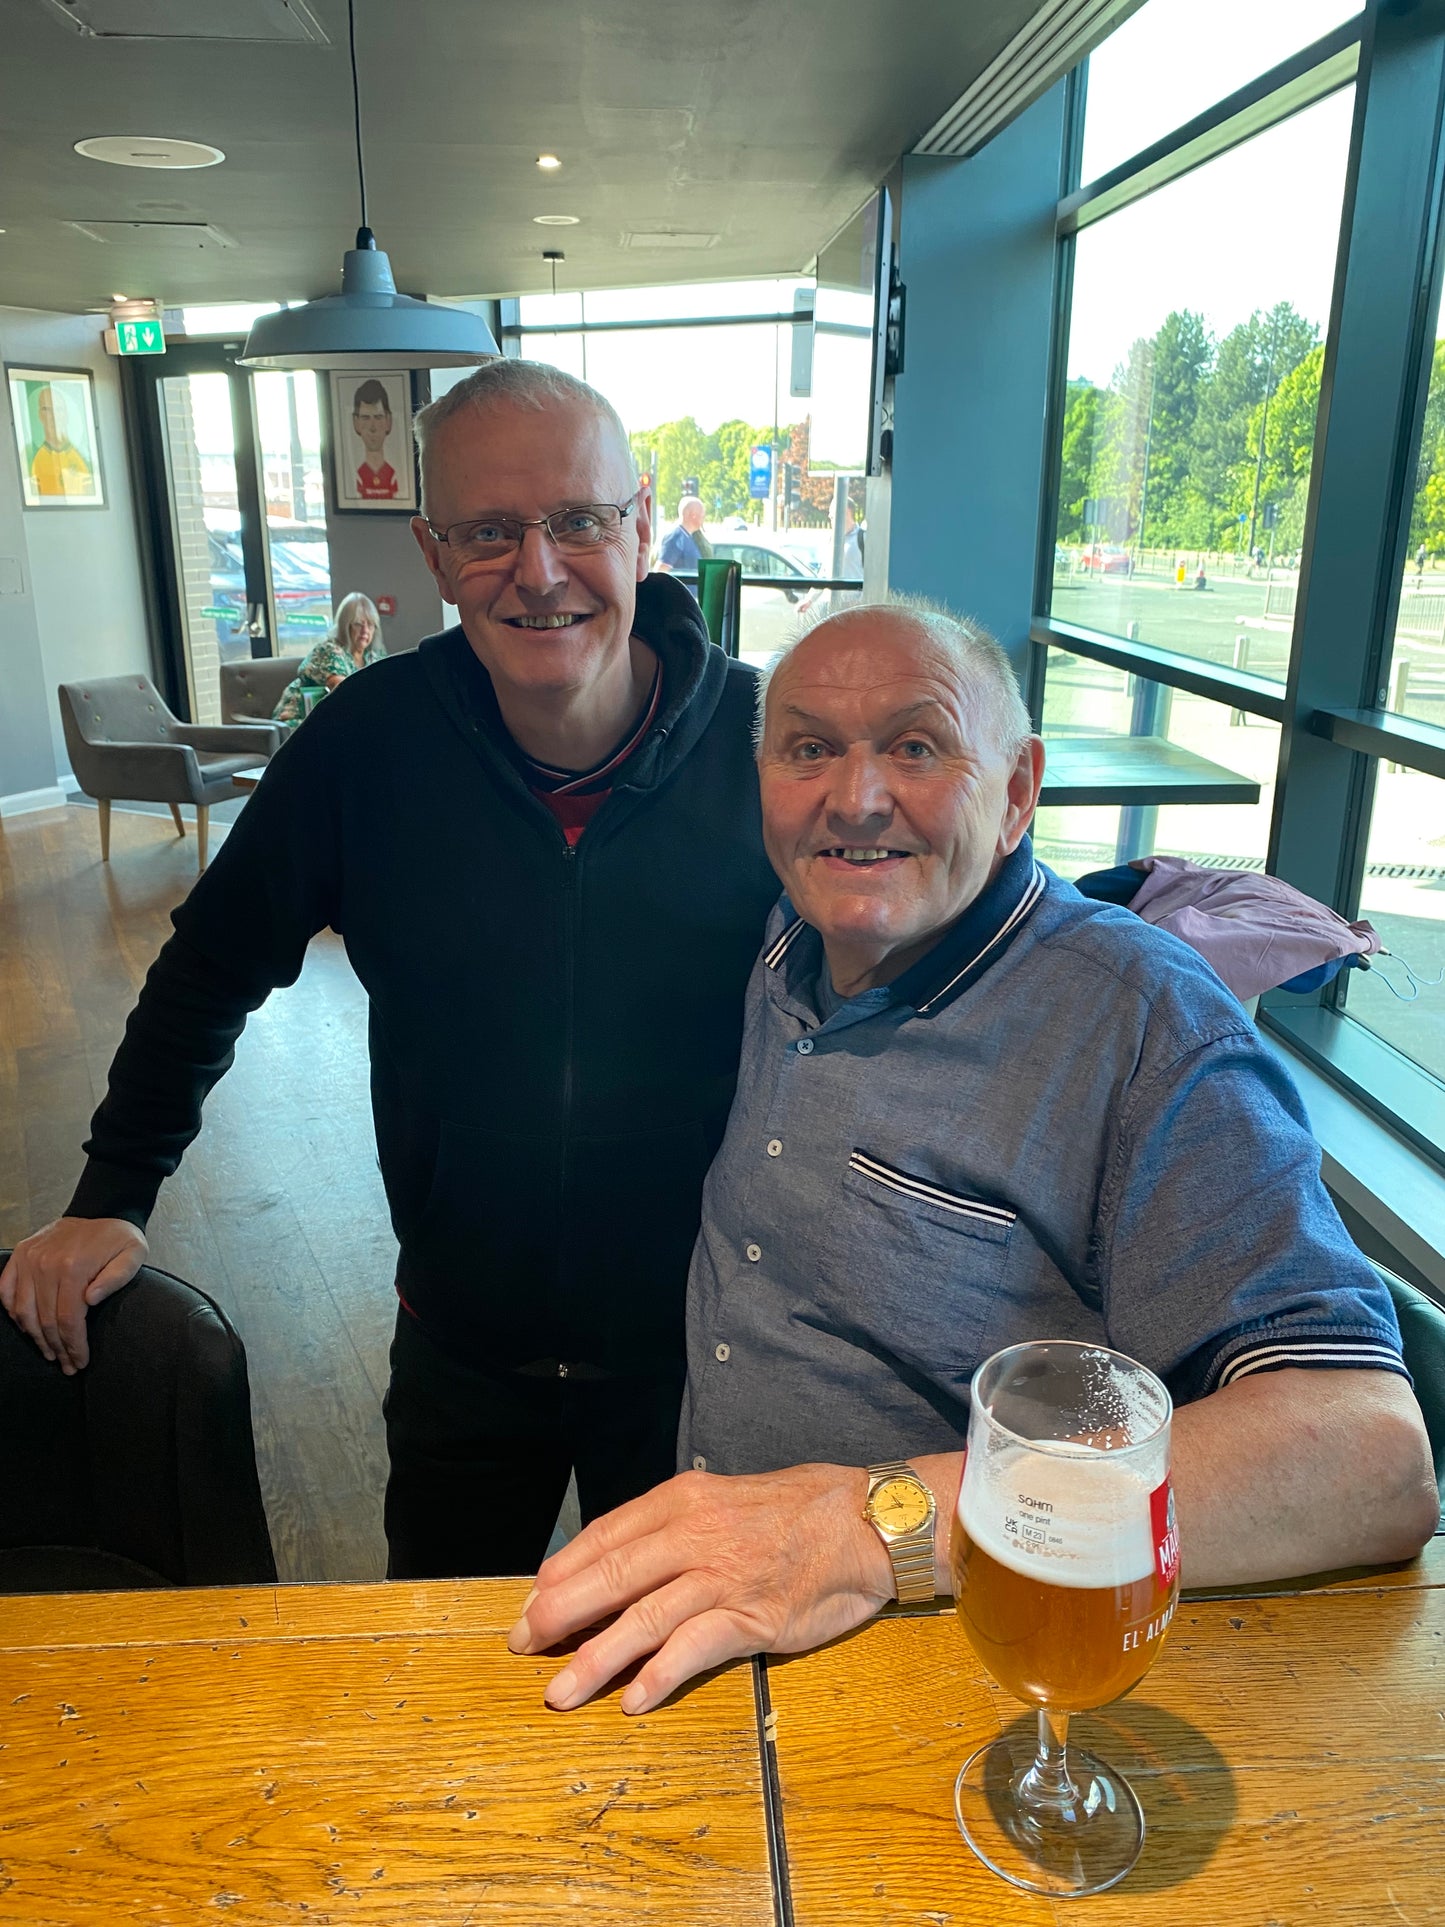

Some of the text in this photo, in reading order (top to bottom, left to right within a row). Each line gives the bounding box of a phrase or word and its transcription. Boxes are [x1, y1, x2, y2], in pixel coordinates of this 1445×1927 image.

[1019, 1510, 1051, 1526] one pint
[1123, 1630, 1140, 1652] EL
